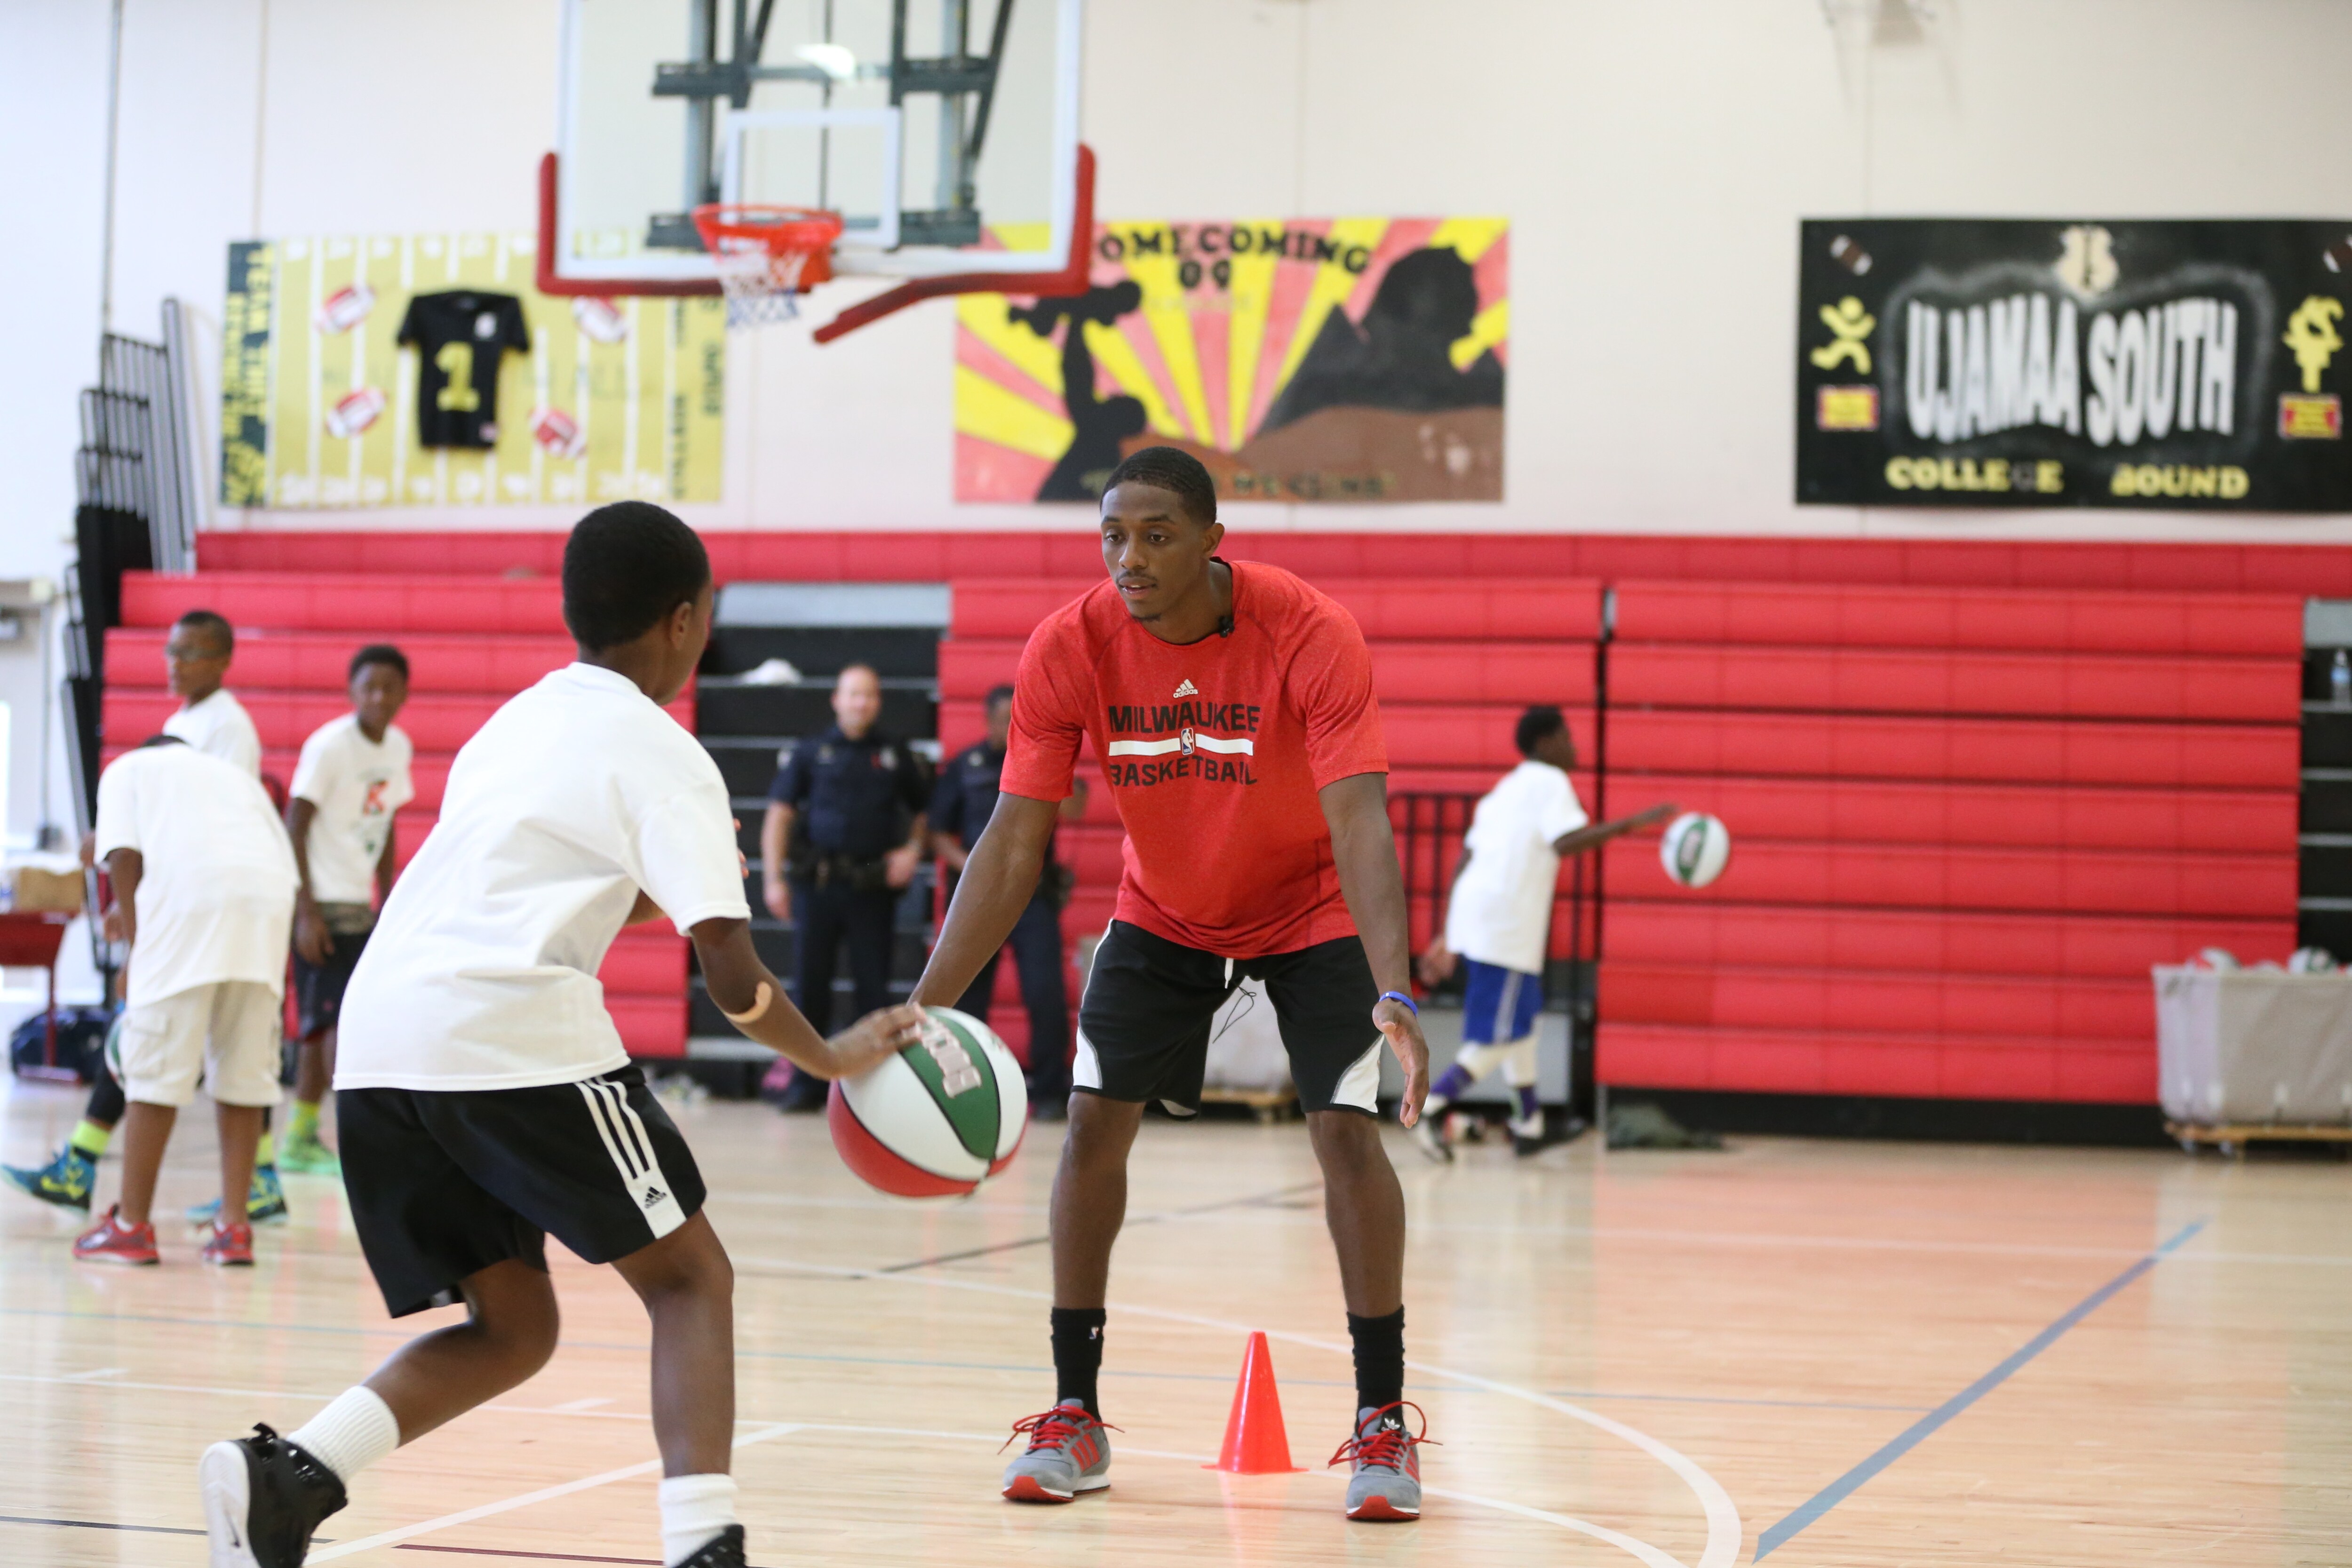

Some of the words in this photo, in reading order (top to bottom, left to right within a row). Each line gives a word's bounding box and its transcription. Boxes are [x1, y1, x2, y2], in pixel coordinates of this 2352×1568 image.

[1099, 225, 1371, 274] OMECOMING
[1180, 259, 1232, 290] 09
[435, 341, 481, 412] 1
[1906, 293, 2081, 444] UJAMAA
[2086, 296, 2239, 447] SOUTH
[2109, 462, 2250, 499] BOUND
[1173, 688, 1199, 699] adidas
[1108, 701, 1261, 733] MILWAUKEE
[1108, 755, 1258, 787] BASKETBALL
